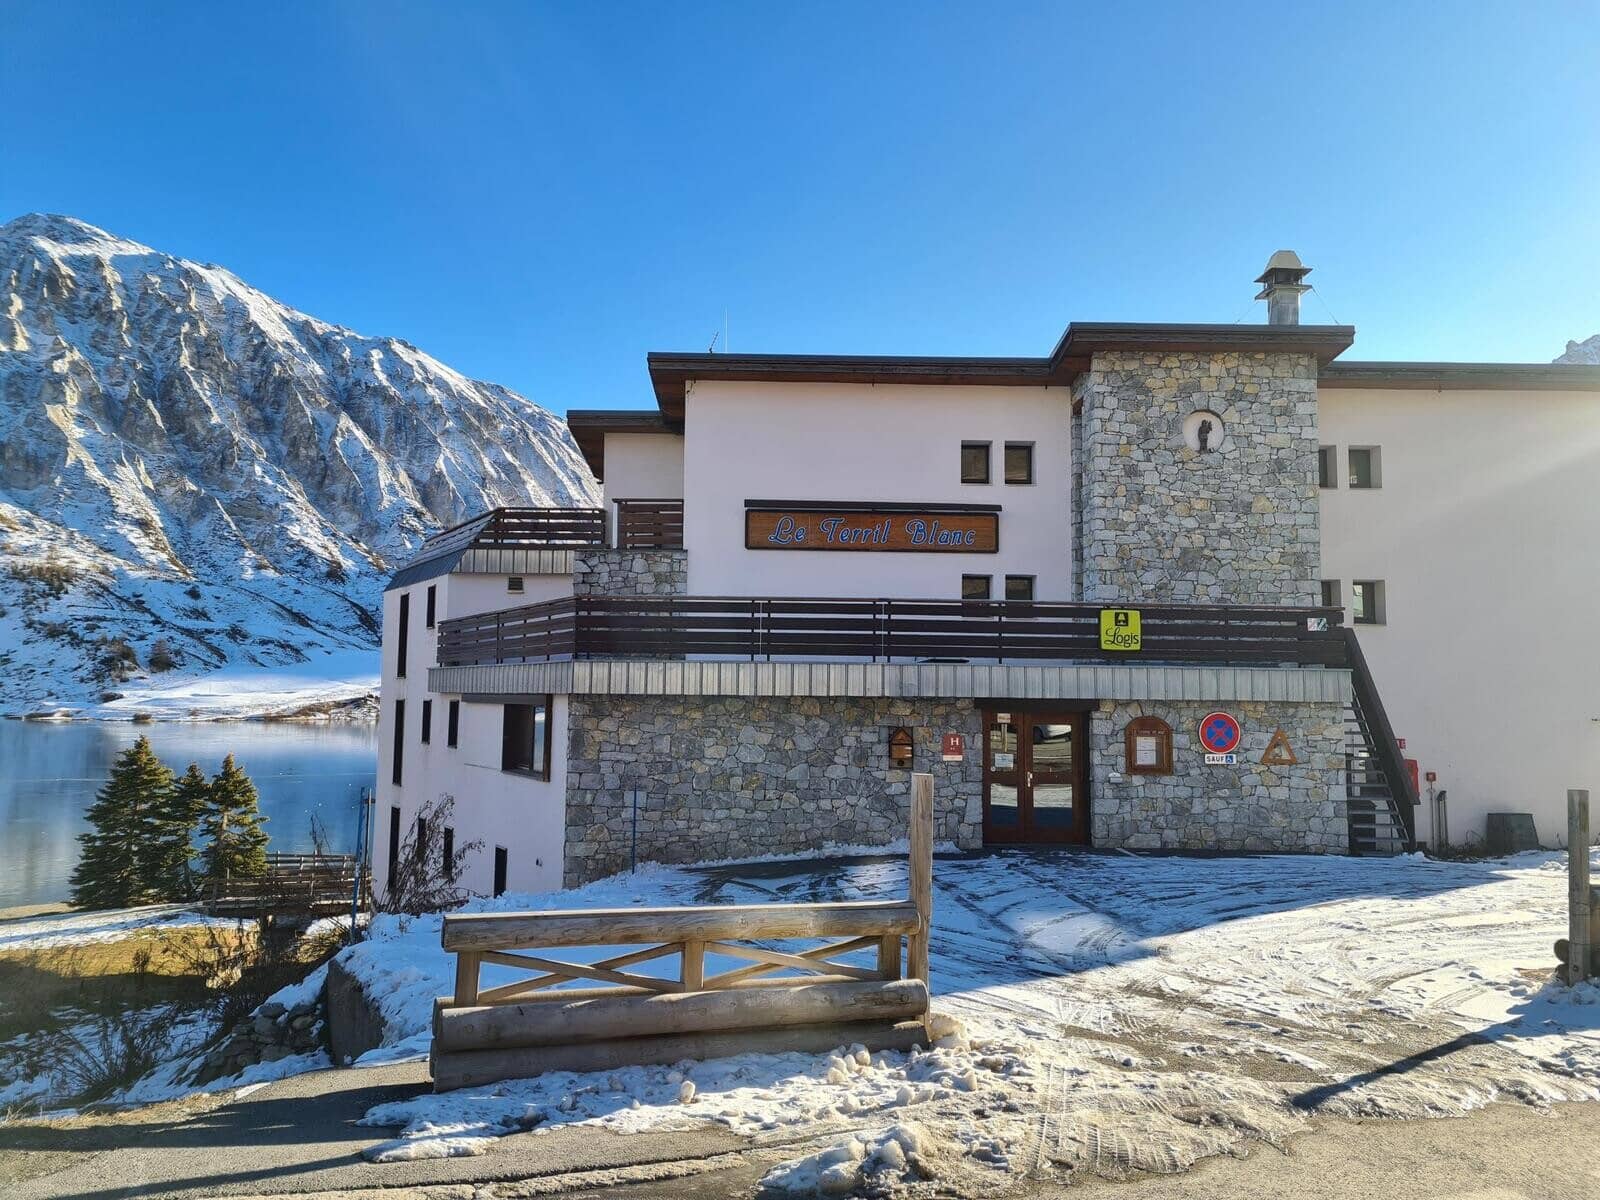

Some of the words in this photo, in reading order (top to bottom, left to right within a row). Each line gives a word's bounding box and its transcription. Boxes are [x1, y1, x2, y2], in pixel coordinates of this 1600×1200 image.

[768, 515, 806, 543] Le
[819, 517, 892, 544] Terril
[906, 519, 976, 545] Blanc
[1104, 627, 1139, 648] Logis
[950, 737, 960, 746] H
[1206, 755, 1225, 763] SAUF
